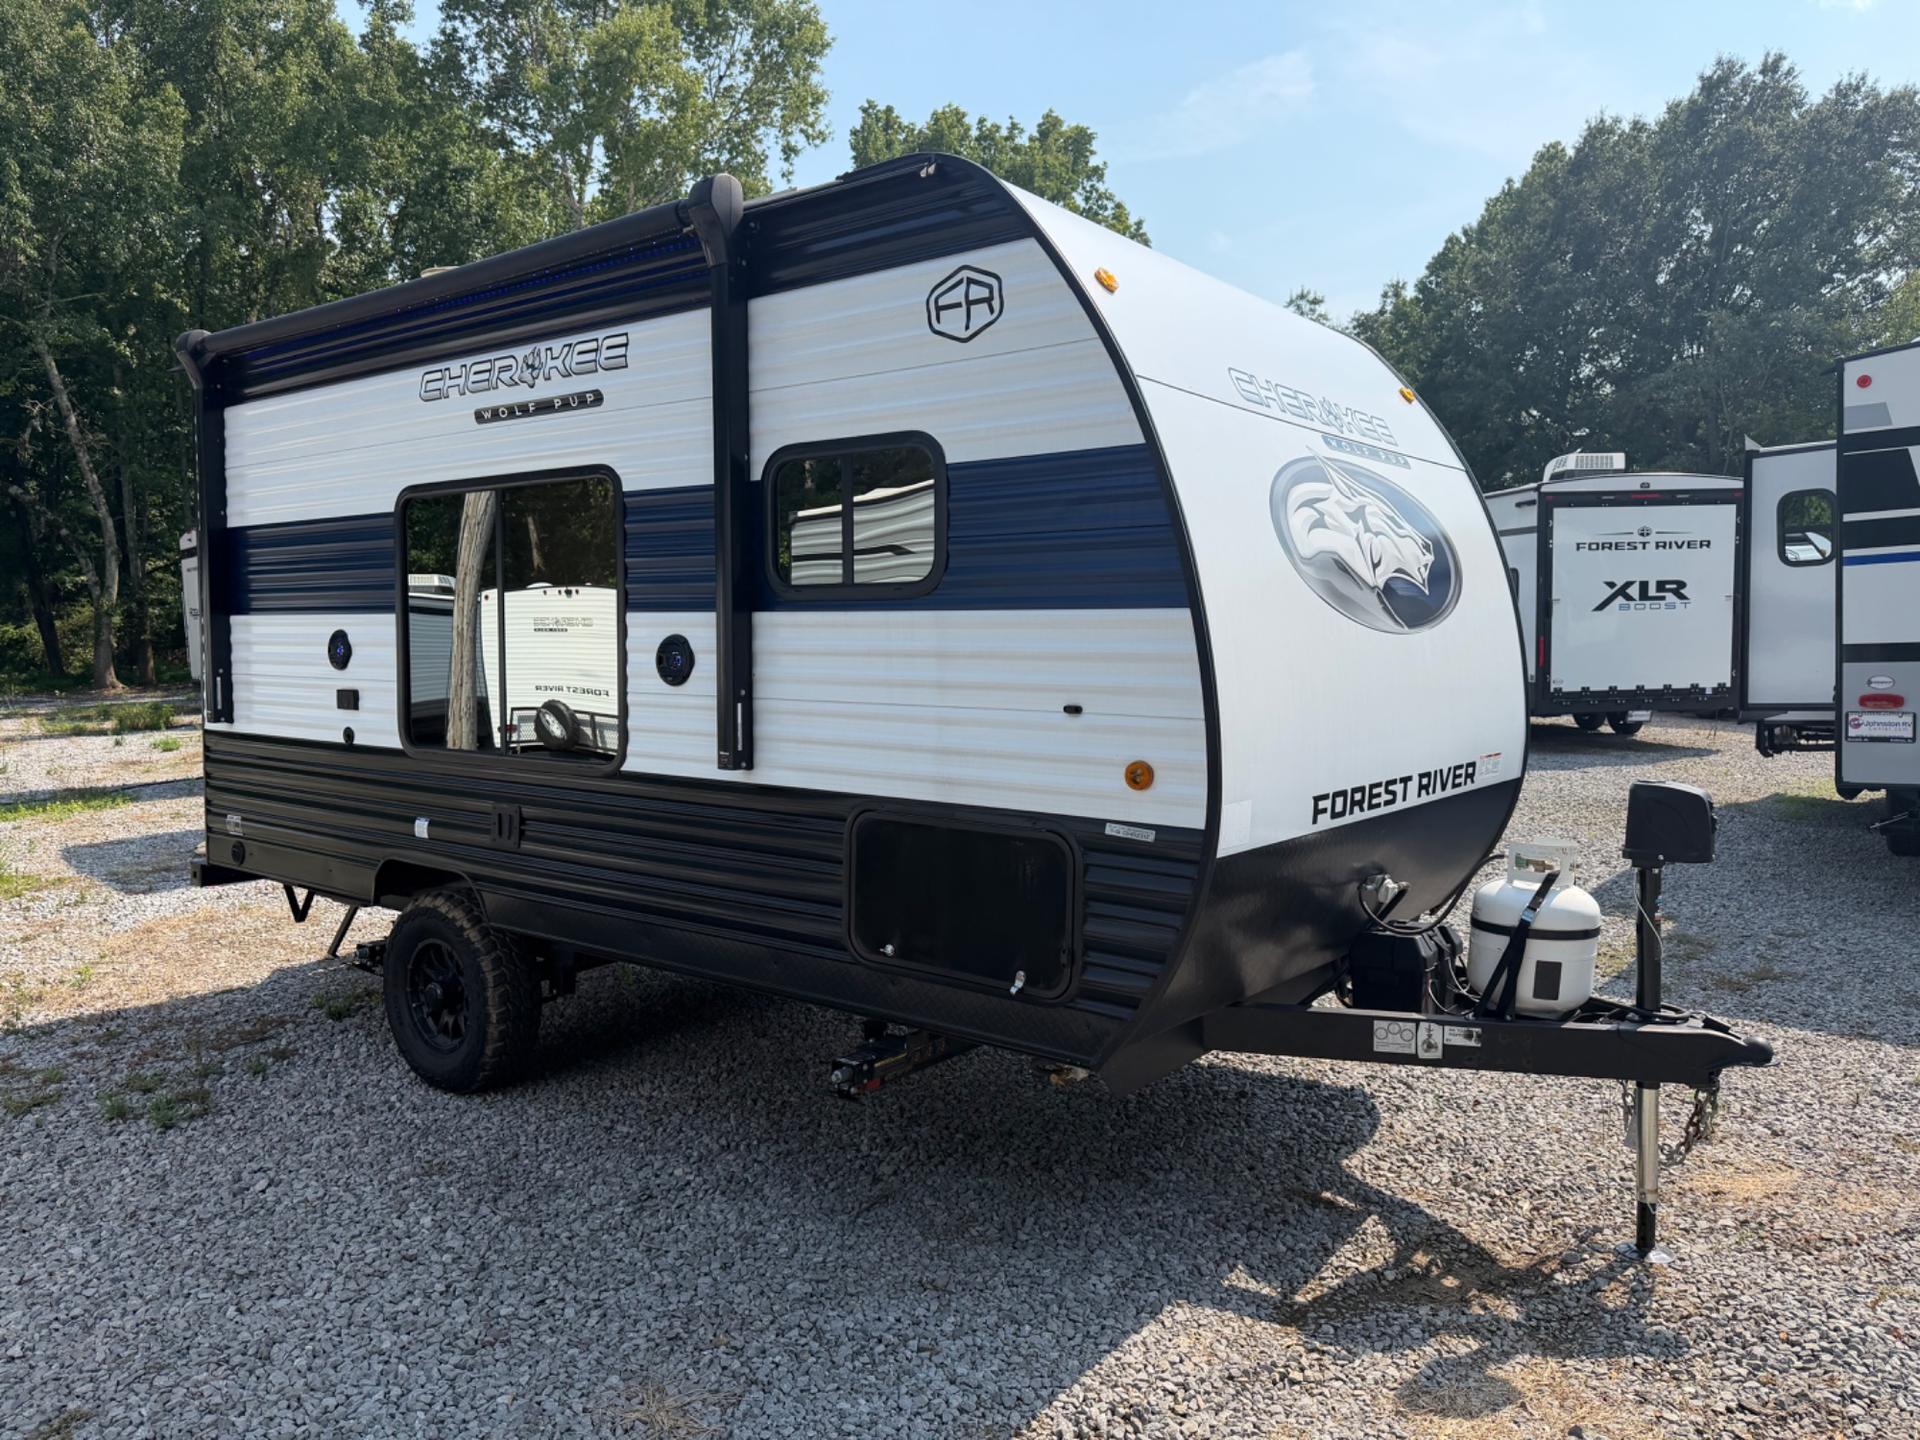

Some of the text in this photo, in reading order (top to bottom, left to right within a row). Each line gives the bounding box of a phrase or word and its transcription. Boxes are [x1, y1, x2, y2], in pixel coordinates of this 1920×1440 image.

[419, 332, 629, 402] CHEROKEE
[481, 393, 595, 420] WOLF PUP
[1576, 539, 1711, 551] FOREST RIVER
[1591, 580, 1691, 612] XLR
[1619, 602, 1691, 611] BOOST
[1312, 775, 1413, 825] FOREST
[1417, 761, 1476, 798] RIVER
